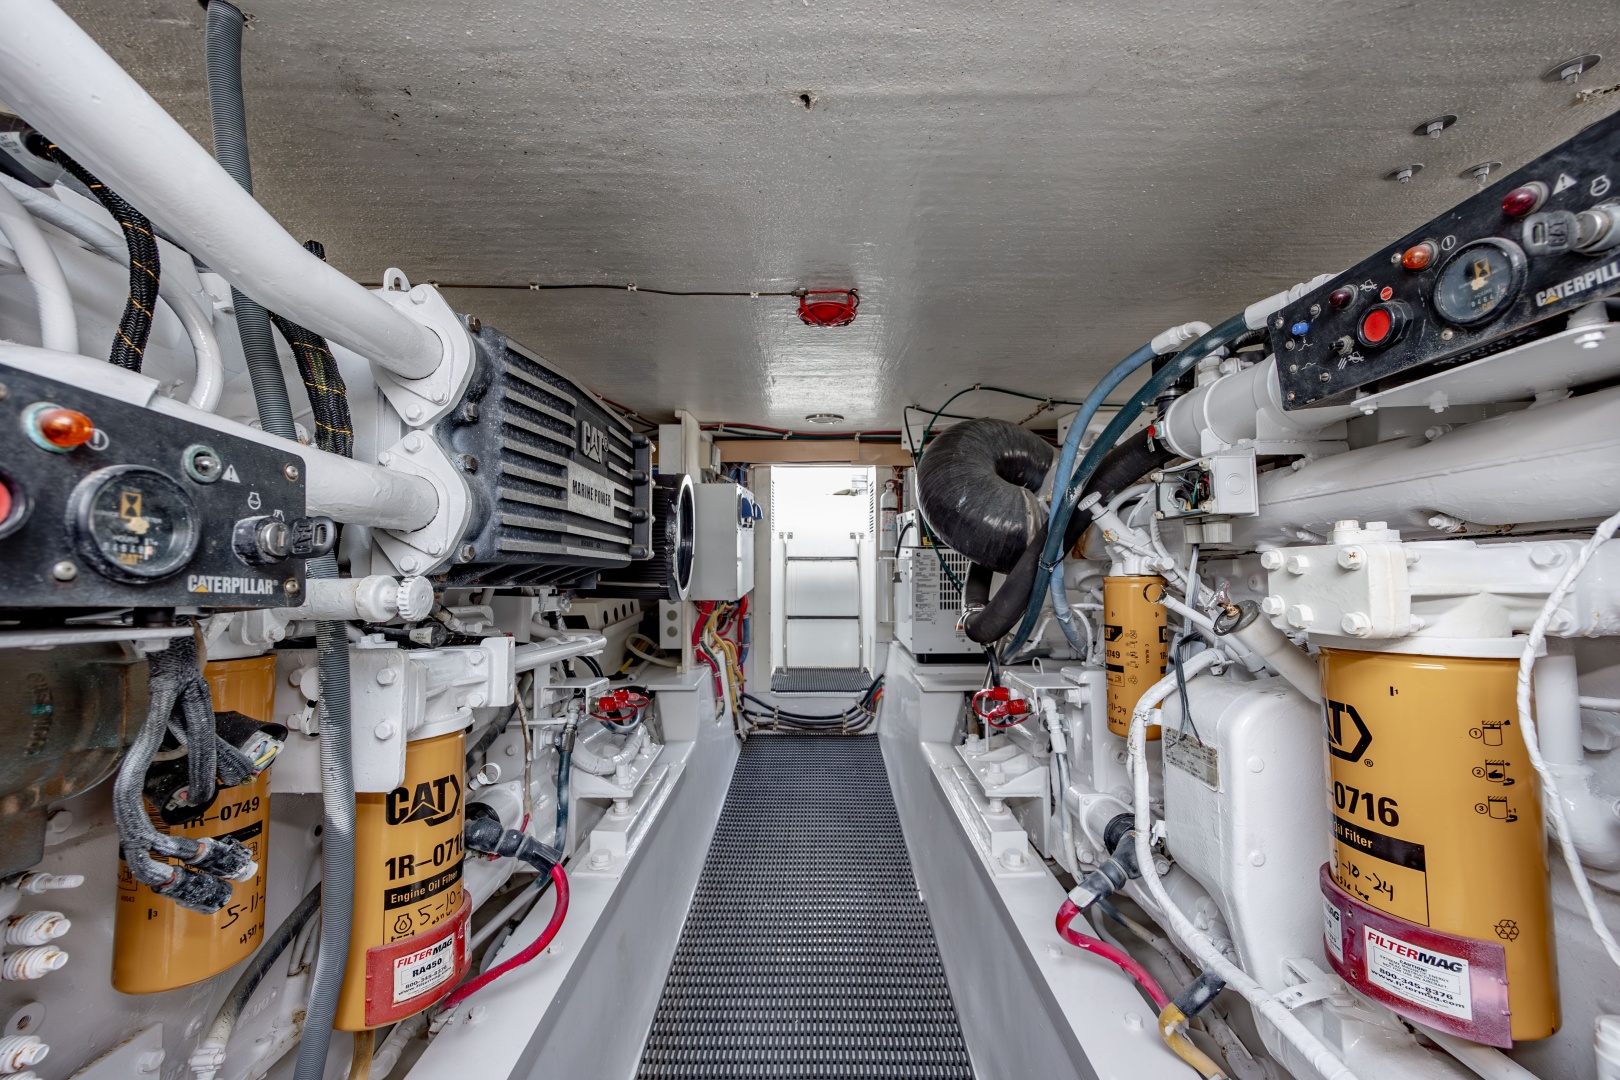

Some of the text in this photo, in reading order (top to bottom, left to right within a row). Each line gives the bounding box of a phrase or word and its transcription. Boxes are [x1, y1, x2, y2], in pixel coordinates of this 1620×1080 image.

[581, 420, 603, 464] CAT
[572, 479, 611, 507] MARINE POWER
[187, 574, 274, 595] CATERPILLAR
[385, 774, 447, 825] CAT
[1344, 827, 1373, 849] Filter
[390, 871, 458, 904] Engine Oil Filter
[397, 937, 453, 968] FILTERMAG
[412, 957, 443, 977] RA450
[1367, 931, 1463, 973] FILTERMAG
[1379, 967, 1453, 1000] 800-345-8376
